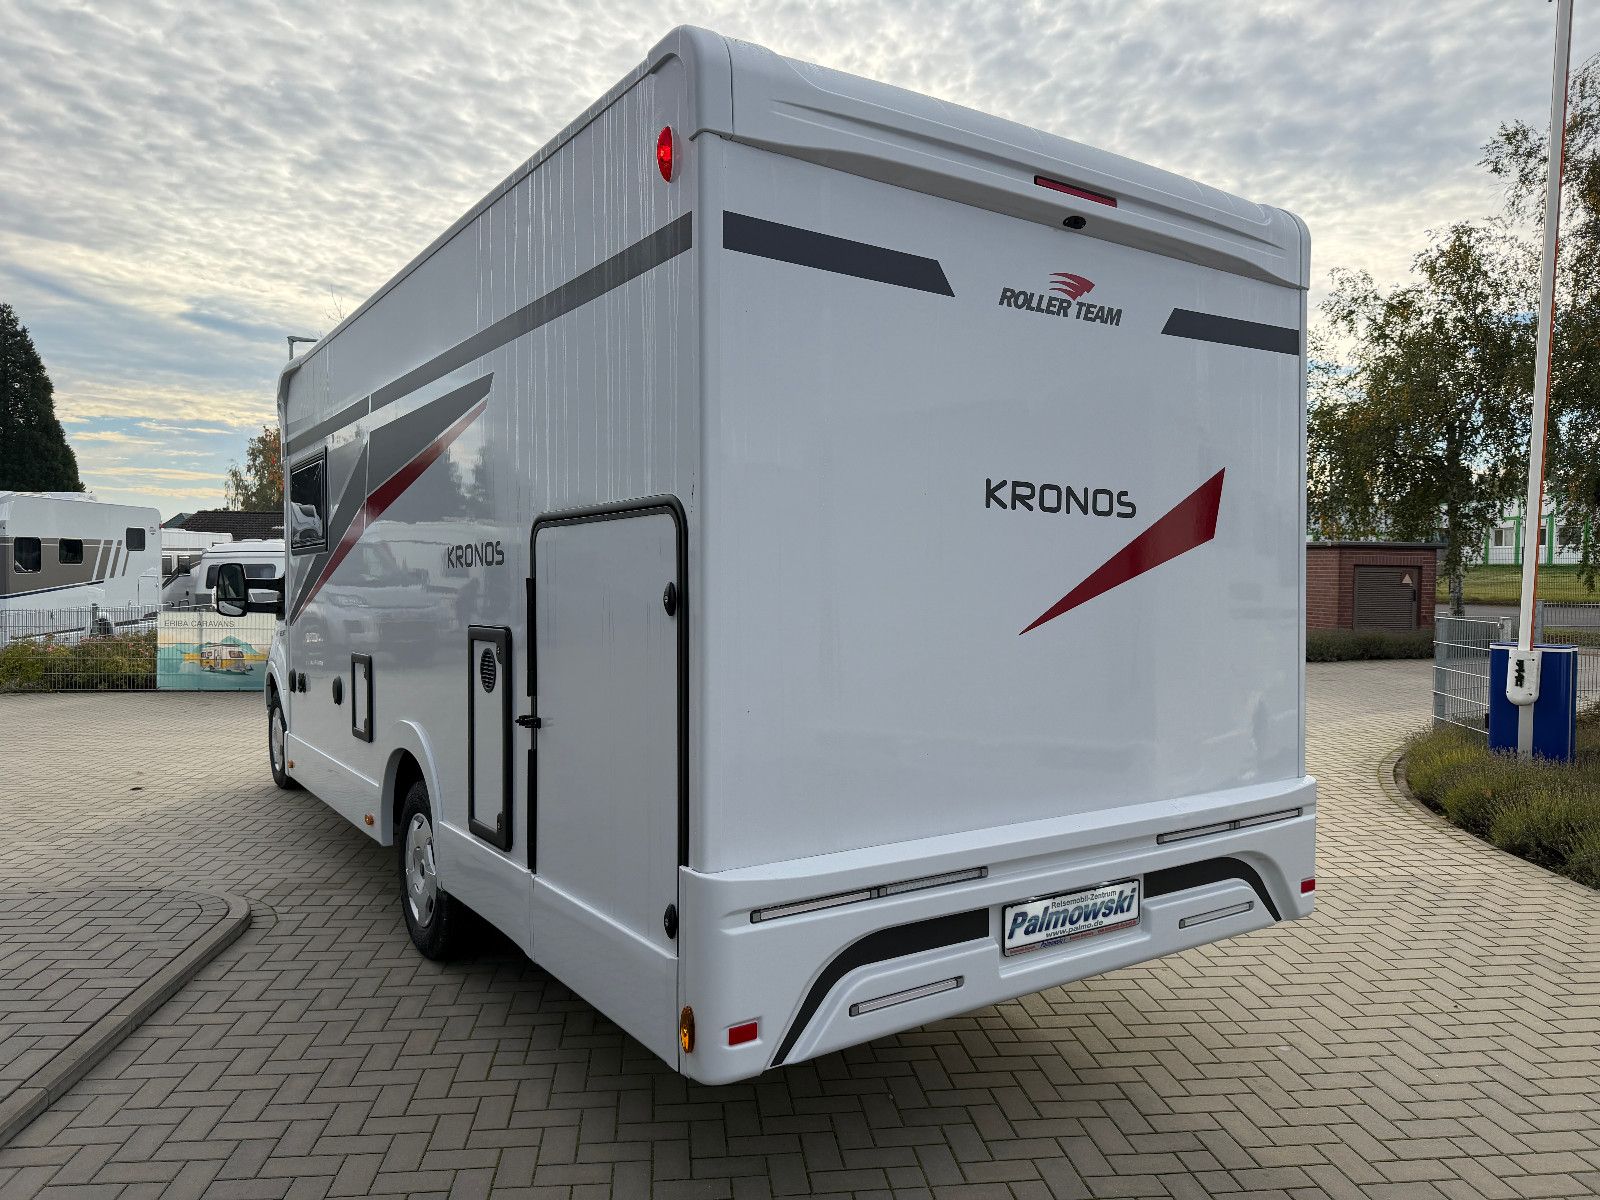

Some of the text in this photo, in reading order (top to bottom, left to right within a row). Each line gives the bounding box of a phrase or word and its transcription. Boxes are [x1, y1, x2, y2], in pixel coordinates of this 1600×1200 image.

[998, 287, 1123, 326] ROLLER TEAM
[985, 478, 1137, 518] KRONOS
[447, 540, 505, 568] KRONOS
[1008, 888, 1136, 939] Palmowski
[1051, 890, 1117, 909] Reisemobil-Zentrum
[1045, 920, 1104, 938] www.palmo.de
